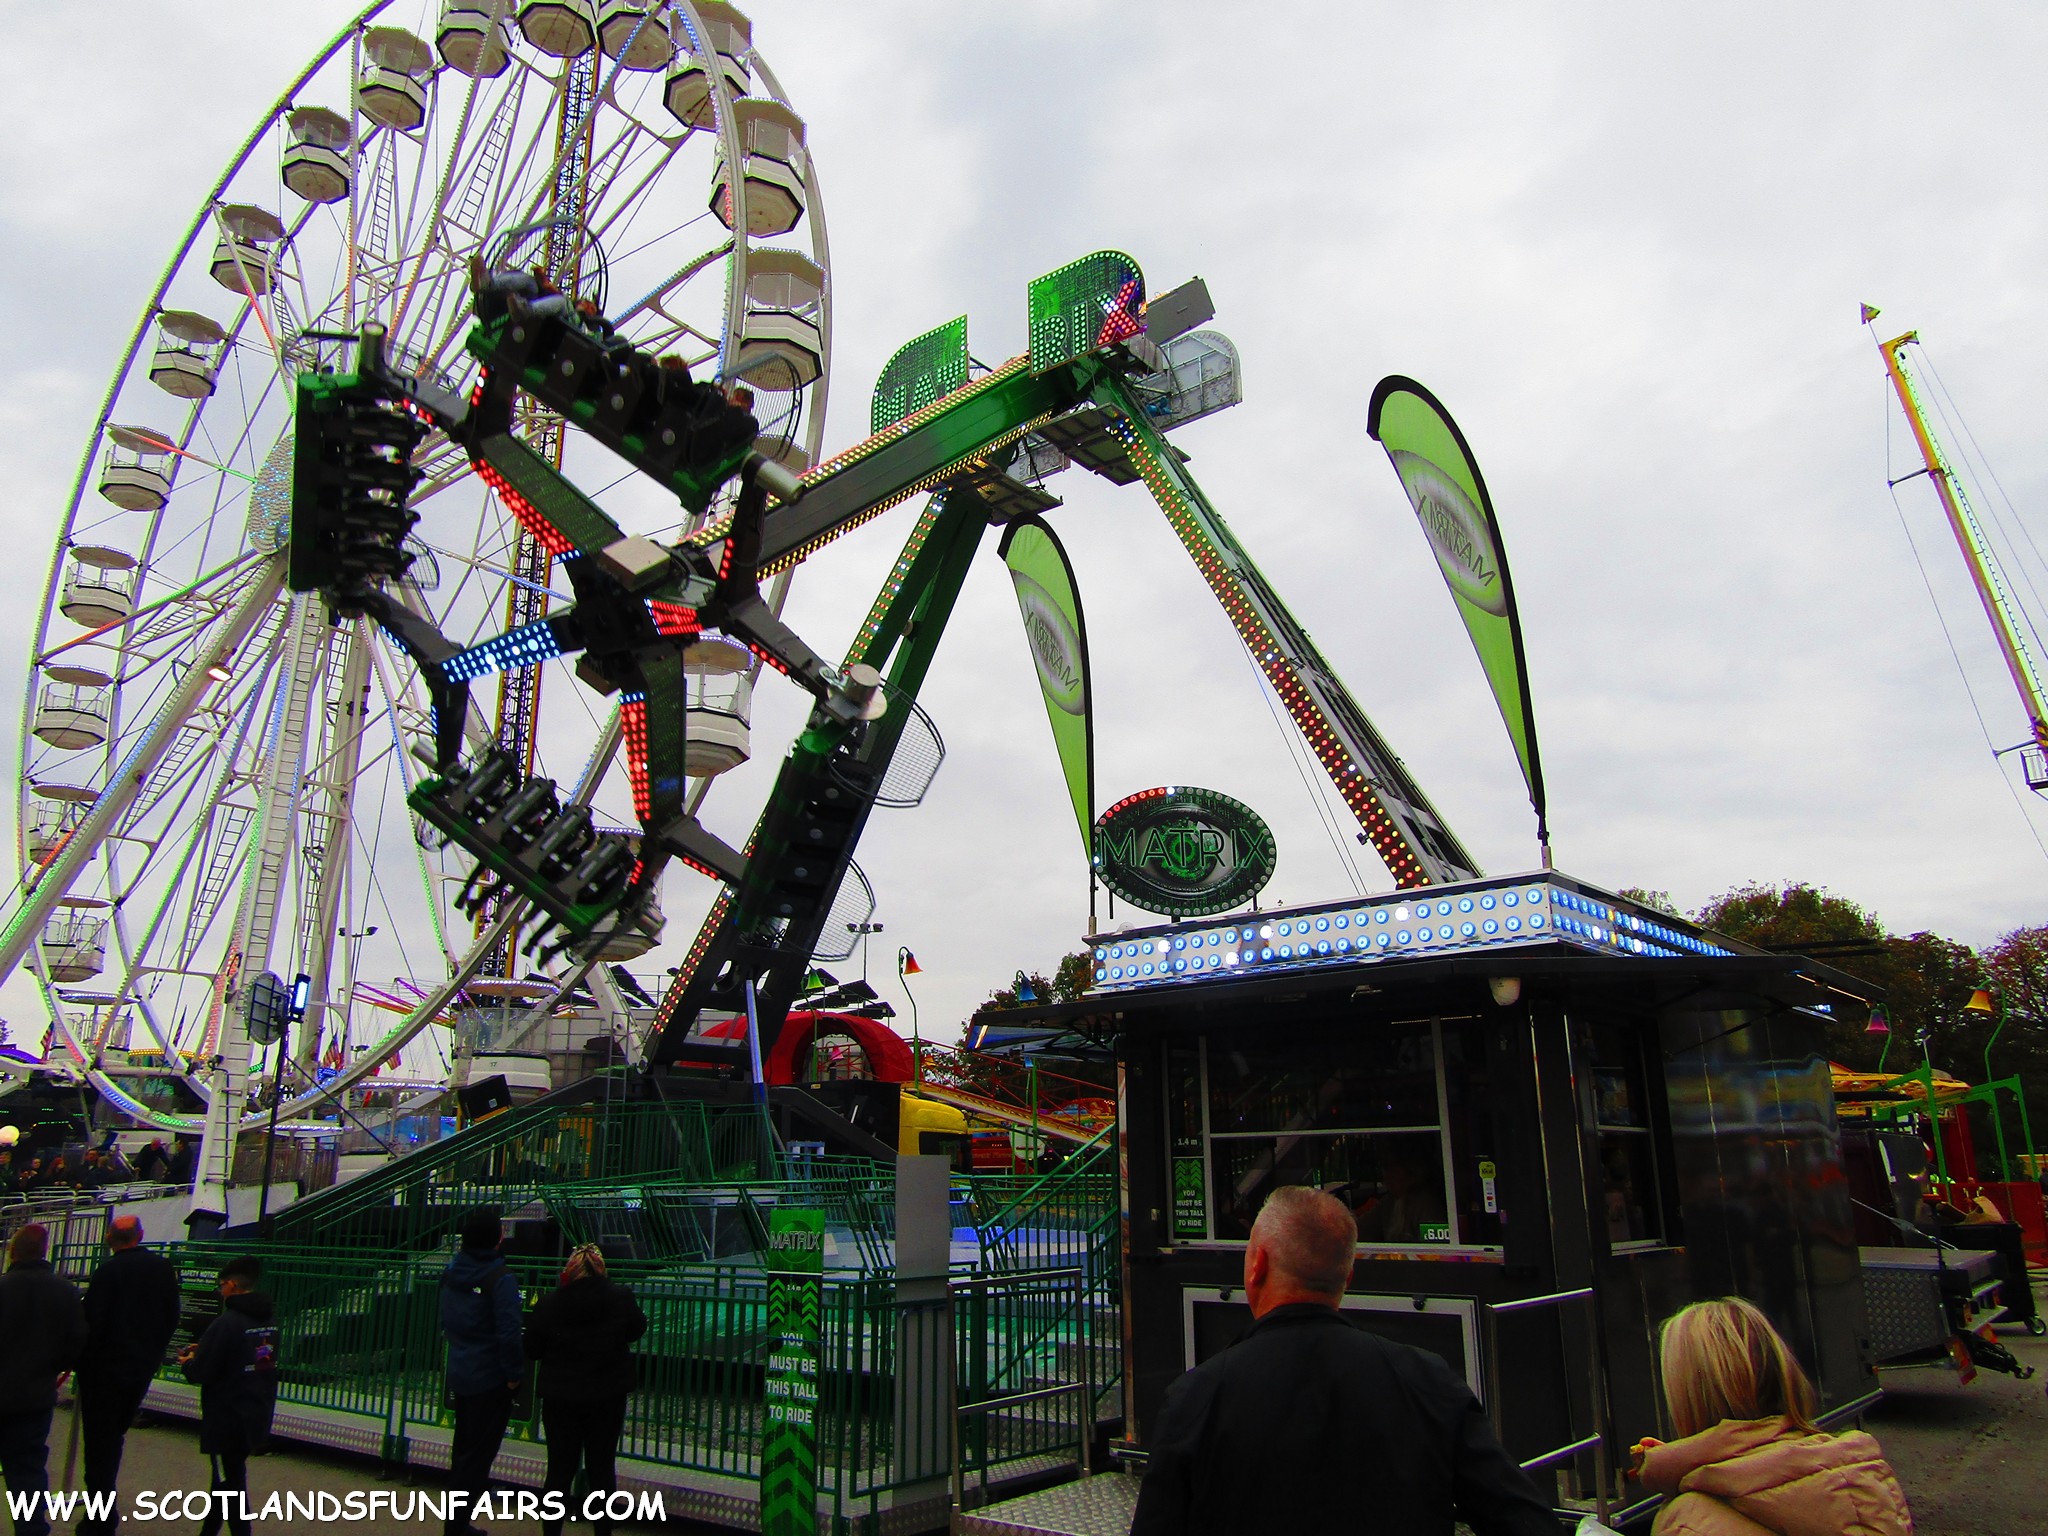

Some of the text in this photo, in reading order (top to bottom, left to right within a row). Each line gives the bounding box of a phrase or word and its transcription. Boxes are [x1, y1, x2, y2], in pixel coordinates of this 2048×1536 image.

[1030, 279, 1142, 374] RIX
[1100, 827, 1270, 869] MATRIX
[1177, 1137, 1189, 1146] 1.4
[1182, 1189, 1196, 1197] YOU
[1176, 1199, 1203, 1207] MUST BE
[1190, 1209, 1204, 1217] TALL
[1187, 1219, 1203, 1227] RIDE
[769, 1230, 821, 1250] MATRIX
[180, 1269, 219, 1279] SAFETY NOTICE
[781, 1331, 804, 1347] YOU
[769, 1355, 817, 1373] MUST BE
[766, 1379, 818, 1399] THIS TALL
[769, 1404, 812, 1423] TO RIDE
